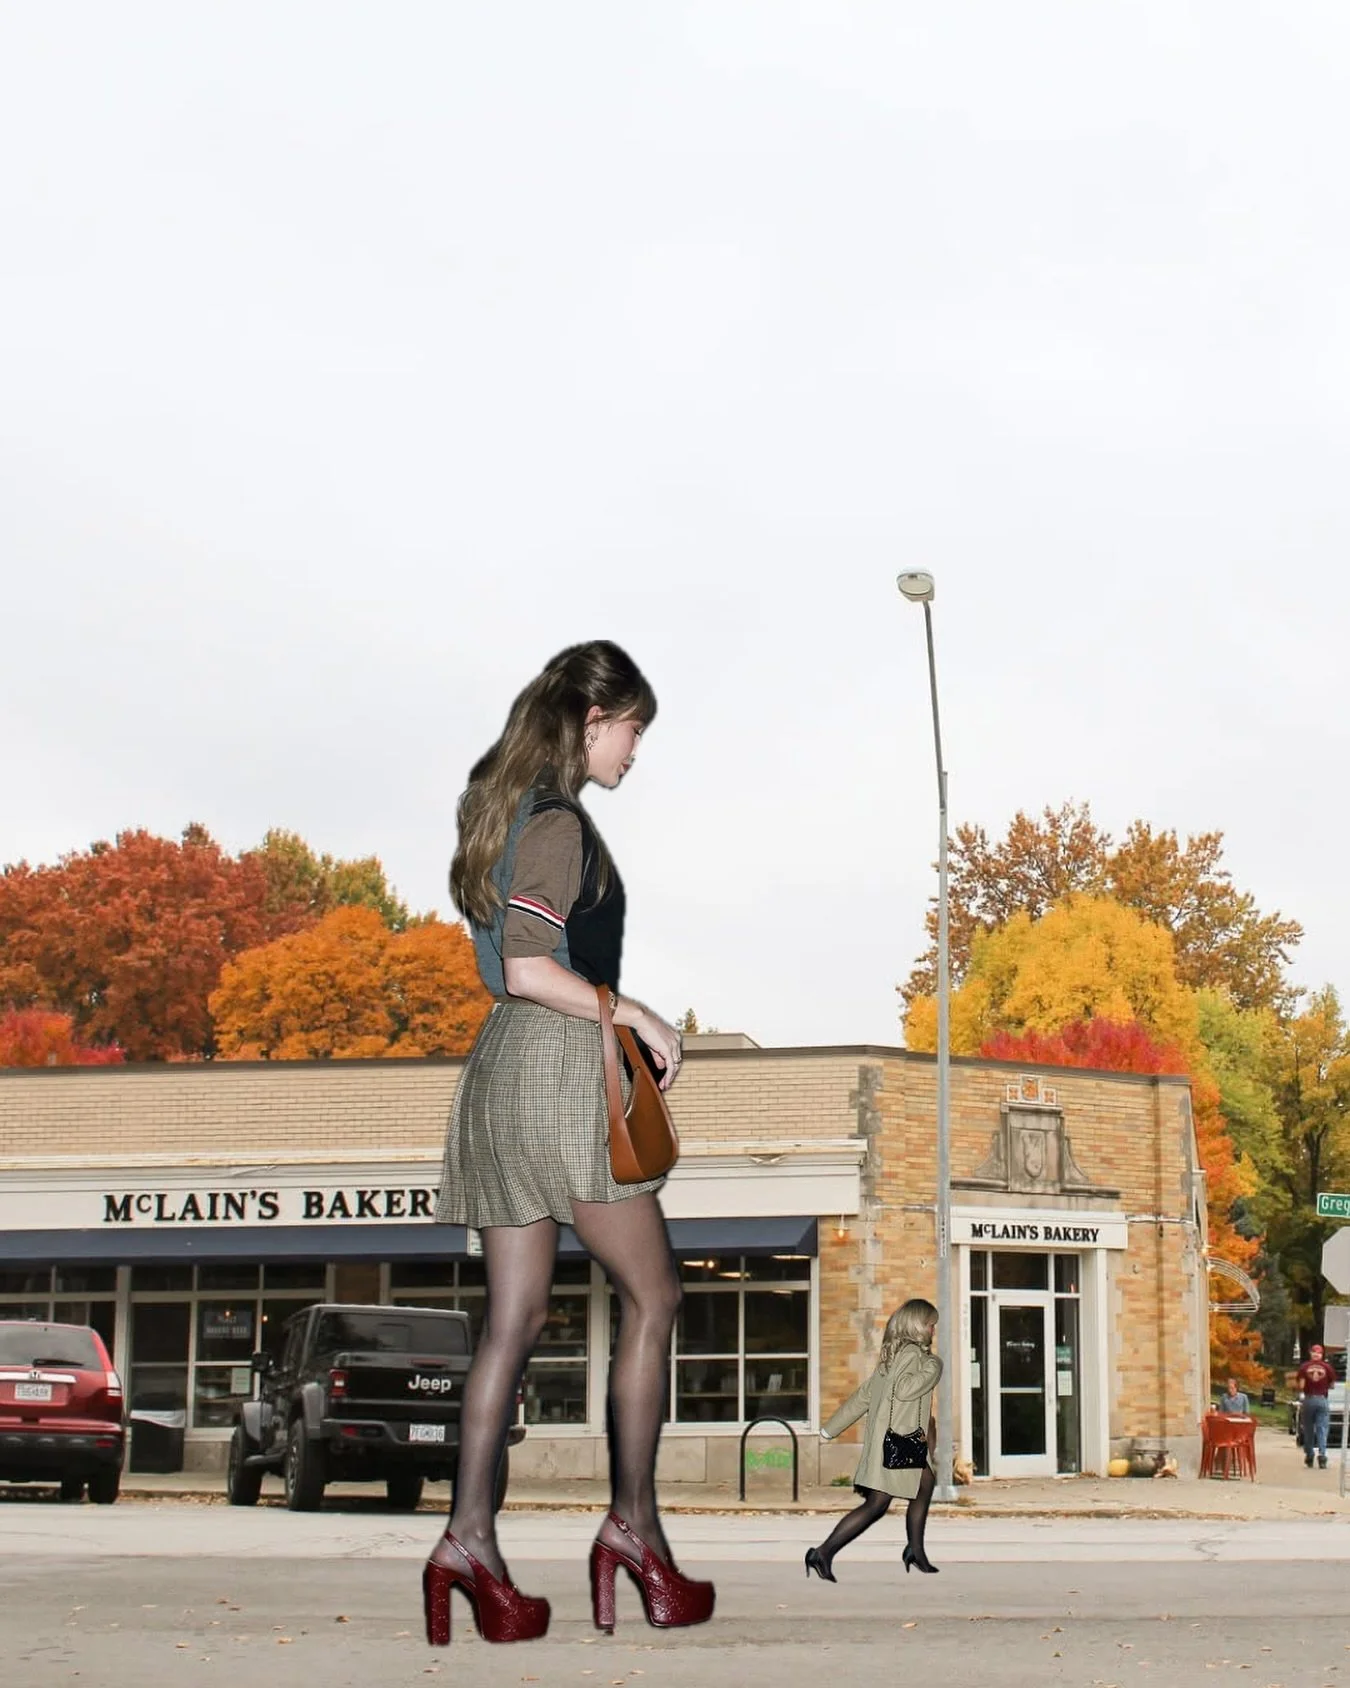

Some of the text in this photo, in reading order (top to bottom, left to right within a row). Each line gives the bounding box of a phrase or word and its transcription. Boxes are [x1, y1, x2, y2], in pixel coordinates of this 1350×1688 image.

[303, 1189, 439, 1220] BAKER
[1044, 1226, 1100, 1242] BAKERY
[408, 1374, 452, 1393] Jeep
